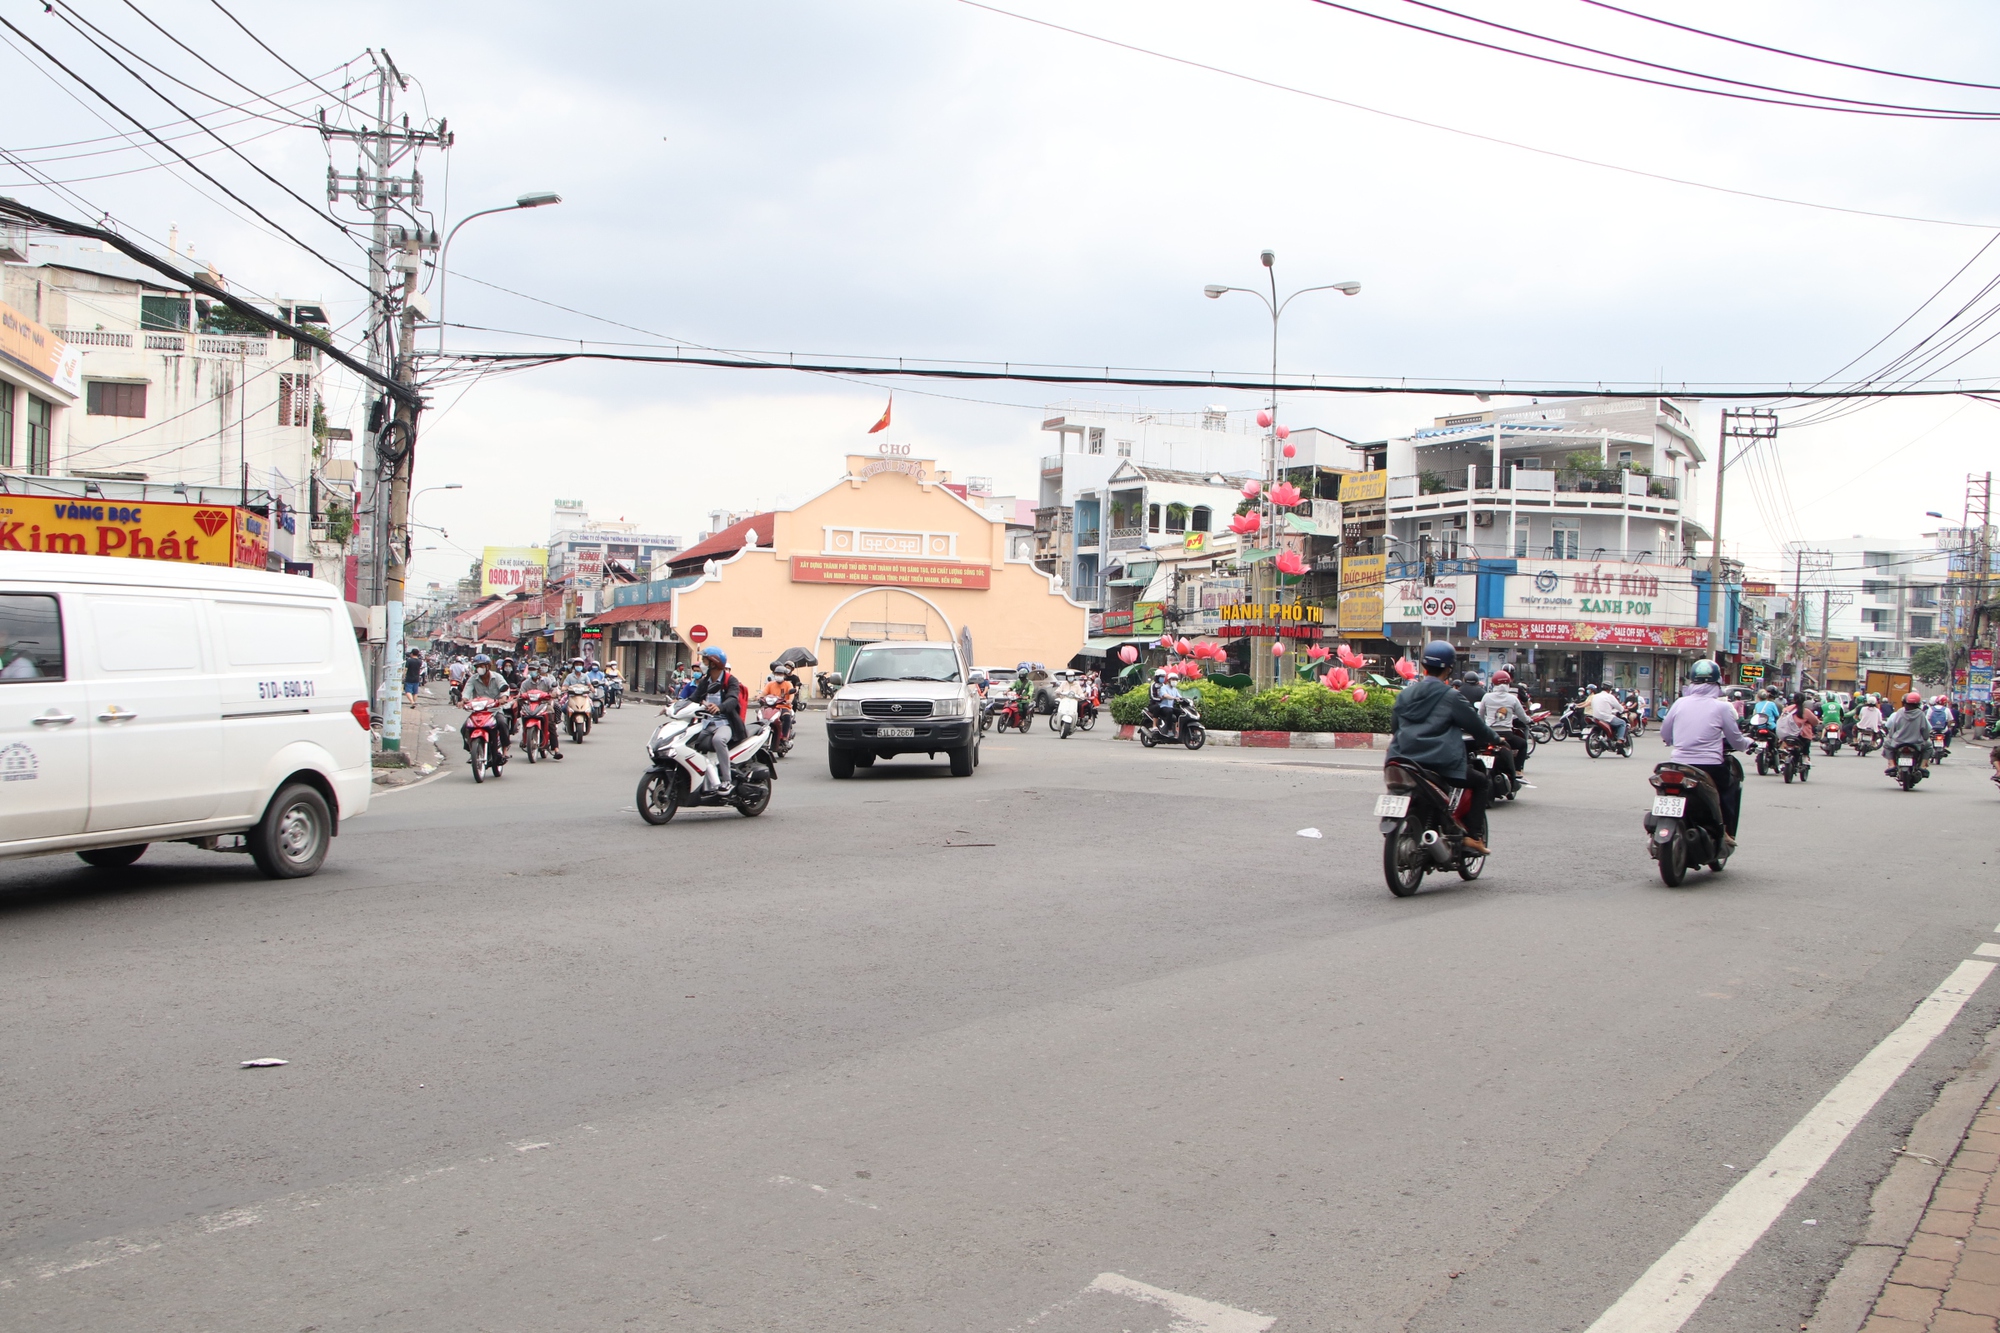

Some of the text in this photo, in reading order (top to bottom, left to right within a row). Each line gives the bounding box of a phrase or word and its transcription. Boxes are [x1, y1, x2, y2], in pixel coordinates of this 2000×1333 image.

[879, 443, 910, 456] CHỢ
[54, 502, 142, 525] VÀNG BẠC
[0, 521, 200, 560] Kim Phát
[506, 558, 512, 566] HỆ
[526, 566, 542, 576] NGỌC
[839, 562, 848, 570] PHỐ
[849, 562, 858, 570] THỦ
[858, 563, 867, 571] ĐỨC
[878, 564, 892, 572] THÀNH
[937, 566, 948, 574] CHẤT
[948, 568, 963, 576] LƯỢNG
[964, 568, 976, 576] SỐNG
[1344, 568, 1383, 584] ĐỨC PHÁT
[1574, 564, 1659, 598] MẮT KÍNH
[1520, 596, 1572, 605] THÙY DƯƠNG
[1580, 598, 1652, 615] XANH PON
[1220, 598, 1263, 620] THÀNH
[1270, 596, 1302, 621] PHỐ
[1402, 606, 1422, 616] XAN
[1501, 630, 1518, 638] 2022
[1531, 624, 1570, 634] SALE OFF 50%
[1614, 627, 1646, 638] SALE OFF 50%
[1659, 798, 1680, 806] 59-S3
